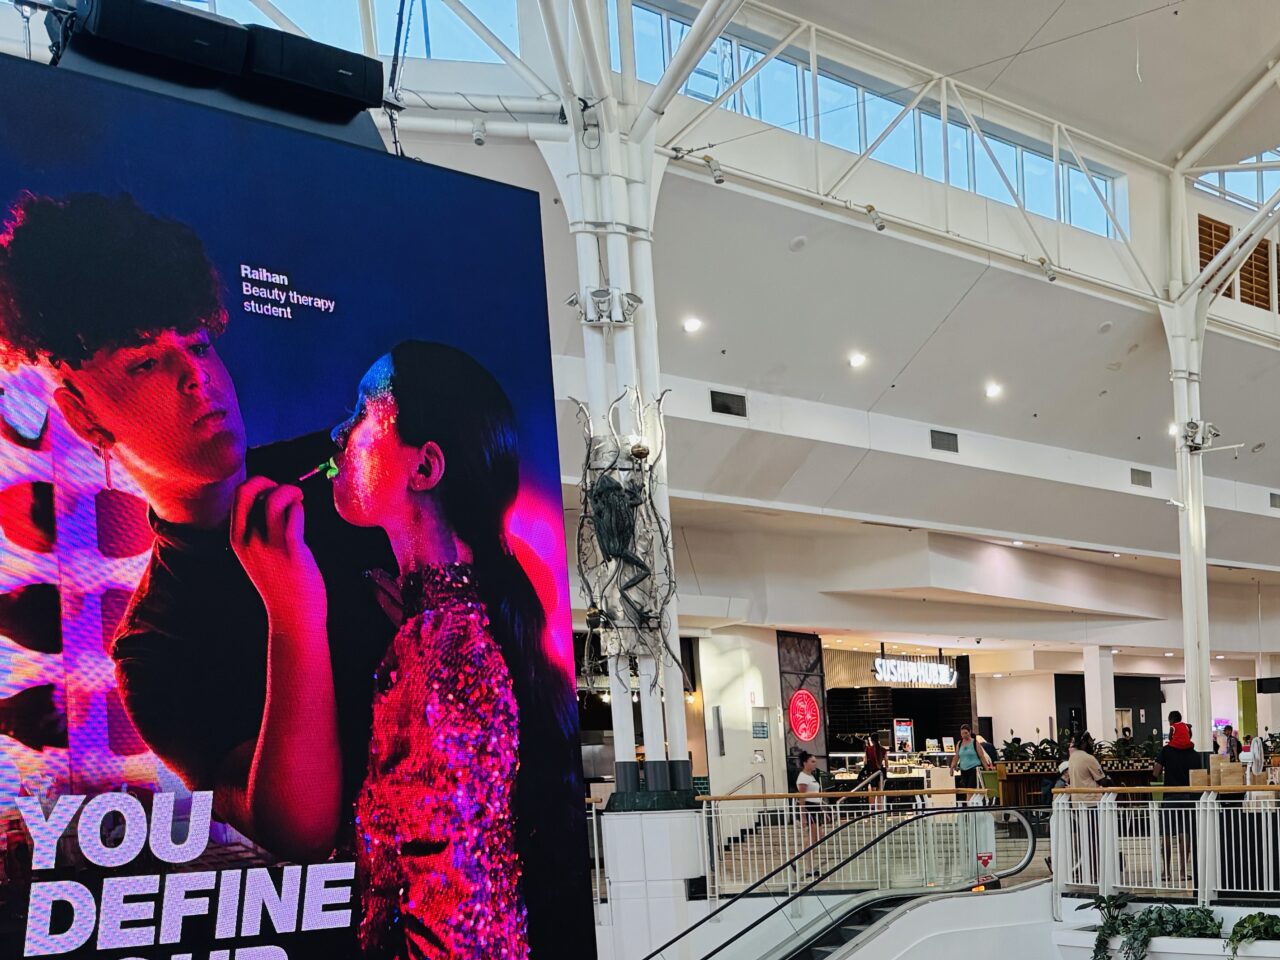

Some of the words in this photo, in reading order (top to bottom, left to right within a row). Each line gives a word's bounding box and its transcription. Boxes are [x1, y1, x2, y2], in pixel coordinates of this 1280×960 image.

[240, 264, 289, 286] Raihan
[242, 281, 286, 304] Beauty
[288, 291, 335, 313] therapy
[243, 300, 292, 319] student
[875, 658, 909, 683] SUSHI
[14, 791, 213, 870] YOU
[23, 862, 356, 956] DEFINE
